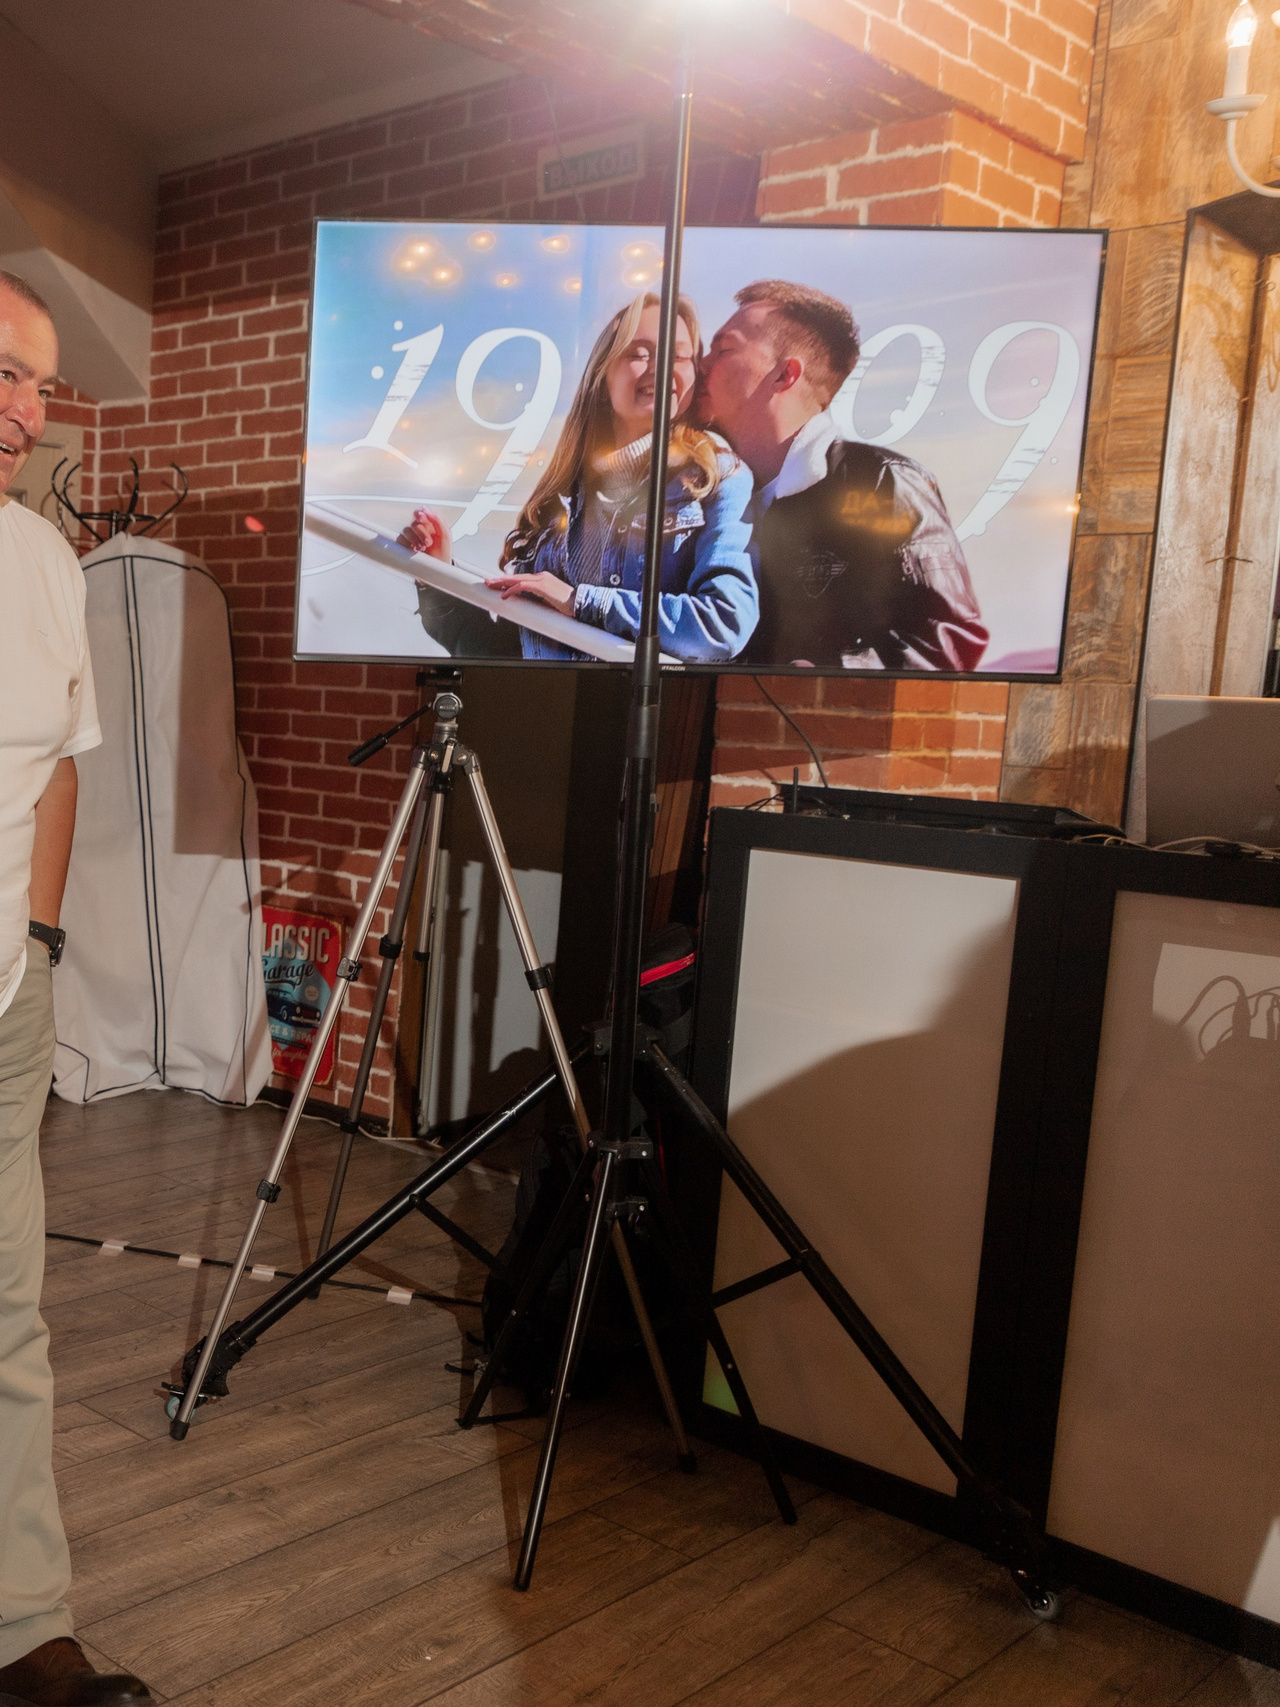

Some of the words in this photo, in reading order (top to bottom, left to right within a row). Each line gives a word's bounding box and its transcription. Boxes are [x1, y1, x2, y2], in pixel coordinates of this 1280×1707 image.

[342, 323, 562, 543] 19
[829, 320, 1080, 543] 09
[262, 922, 330, 963] LASSIC
